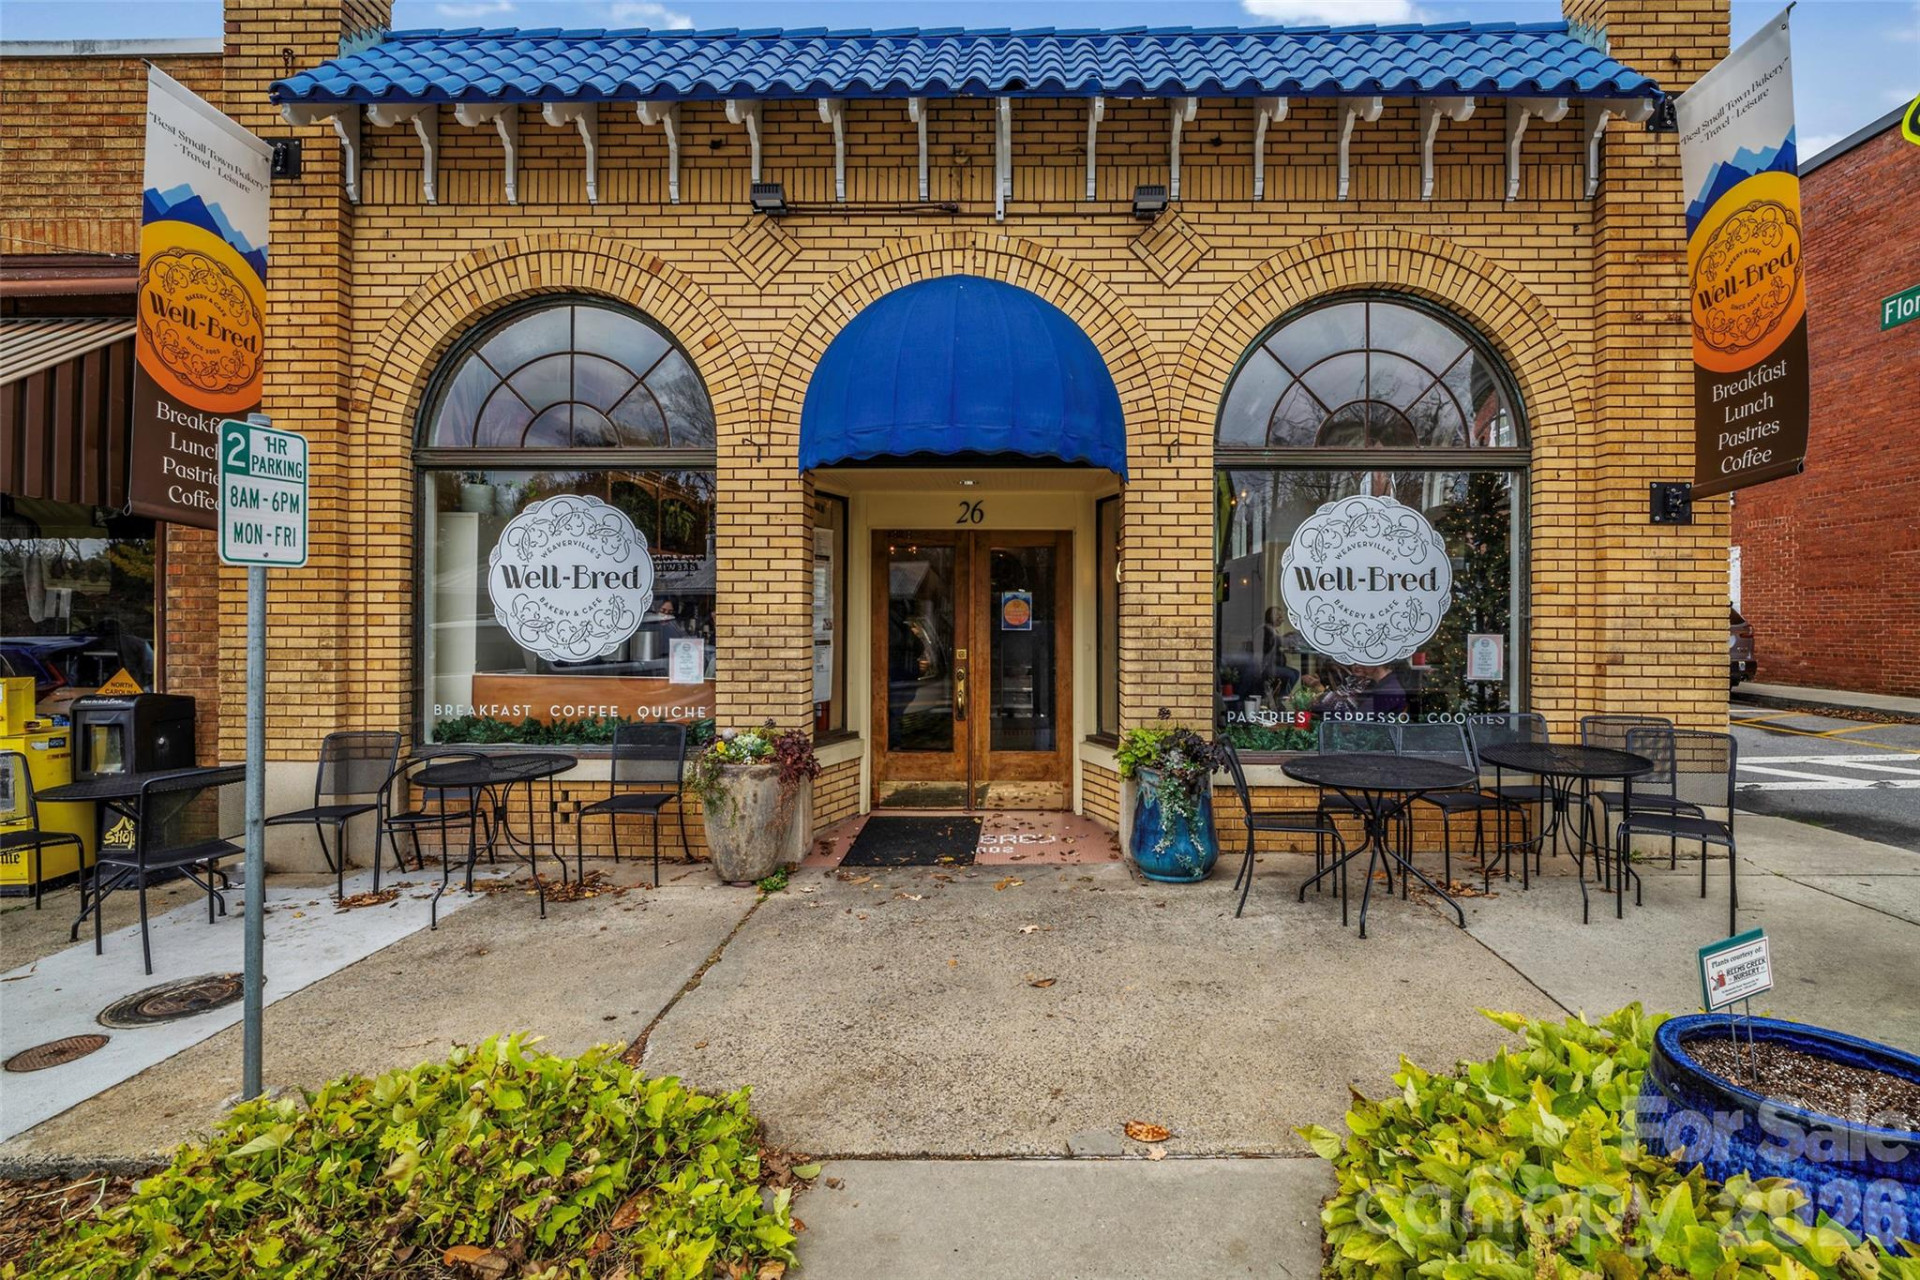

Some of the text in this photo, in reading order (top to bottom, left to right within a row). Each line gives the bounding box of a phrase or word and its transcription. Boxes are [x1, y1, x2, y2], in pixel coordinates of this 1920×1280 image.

[1701, 106, 1725, 131] Small
[1725, 89, 1750, 111] Town
[1704, 115, 1730, 141] Travel
[1736, 88, 1769, 118] Leisure
[178, 130, 206, 154] Small
[207, 146, 234, 171] Town
[179, 143, 211, 170] Travel
[217, 167, 251, 194] Leisure
[1698, 243, 1795, 310] Well-Bred
[150, 290, 258, 354] Well-Bred
[1712, 359, 1787, 403] Breakfast
[1725, 391, 1774, 424] Lunch
[1718, 420, 1780, 450] Pastries
[227, 432, 287, 467] 2 HR
[1721, 446, 1772, 474] Coffee
[251, 454, 303, 479] PARKING
[230, 485, 260, 510] 8AM
[272, 491, 300, 514] 6PM
[956, 499, 984, 524] 26
[233, 521, 263, 545] MON
[275, 525, 296, 547] FRI
[541, 540, 602, 559] WEAVERVILLE'S
[1334, 541, 1398, 561] WEAVERVILLE'S
[500, 564, 642, 590] Well-Bred
[1293, 566, 1440, 592] Well-Bred
[539, 596, 571, 617] BAKERY
[1333, 599, 1366, 620] BAKERY
[434, 704, 706, 719] BREAKFAST COFFEE QUICHE
[1227, 711, 1306, 723] PASTRIES
[1711, 957, 1730, 969] Plants
[1730, 949, 1753, 962] courtesy
